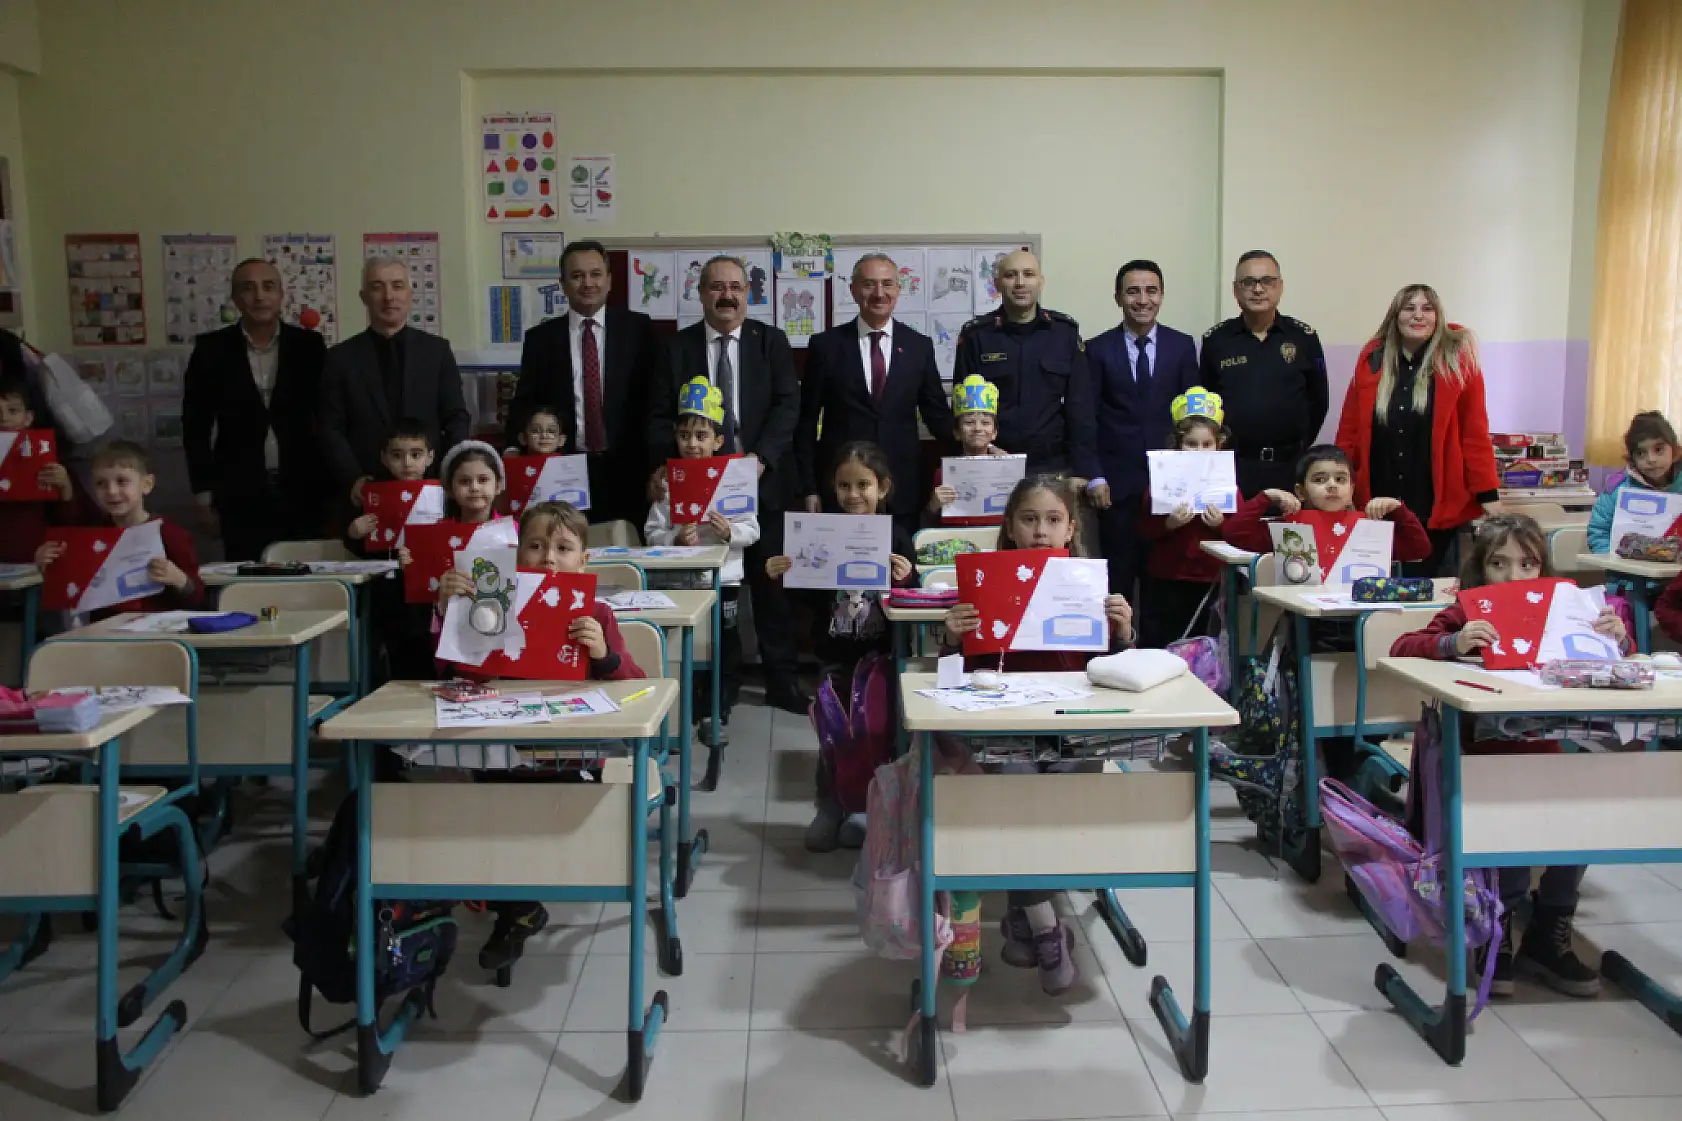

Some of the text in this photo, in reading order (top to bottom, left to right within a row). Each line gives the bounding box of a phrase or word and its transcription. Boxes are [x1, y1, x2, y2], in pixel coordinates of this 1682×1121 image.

[688, 384, 708, 410] R
[966, 385, 987, 408] K
[1186, 394, 1206, 414] E
